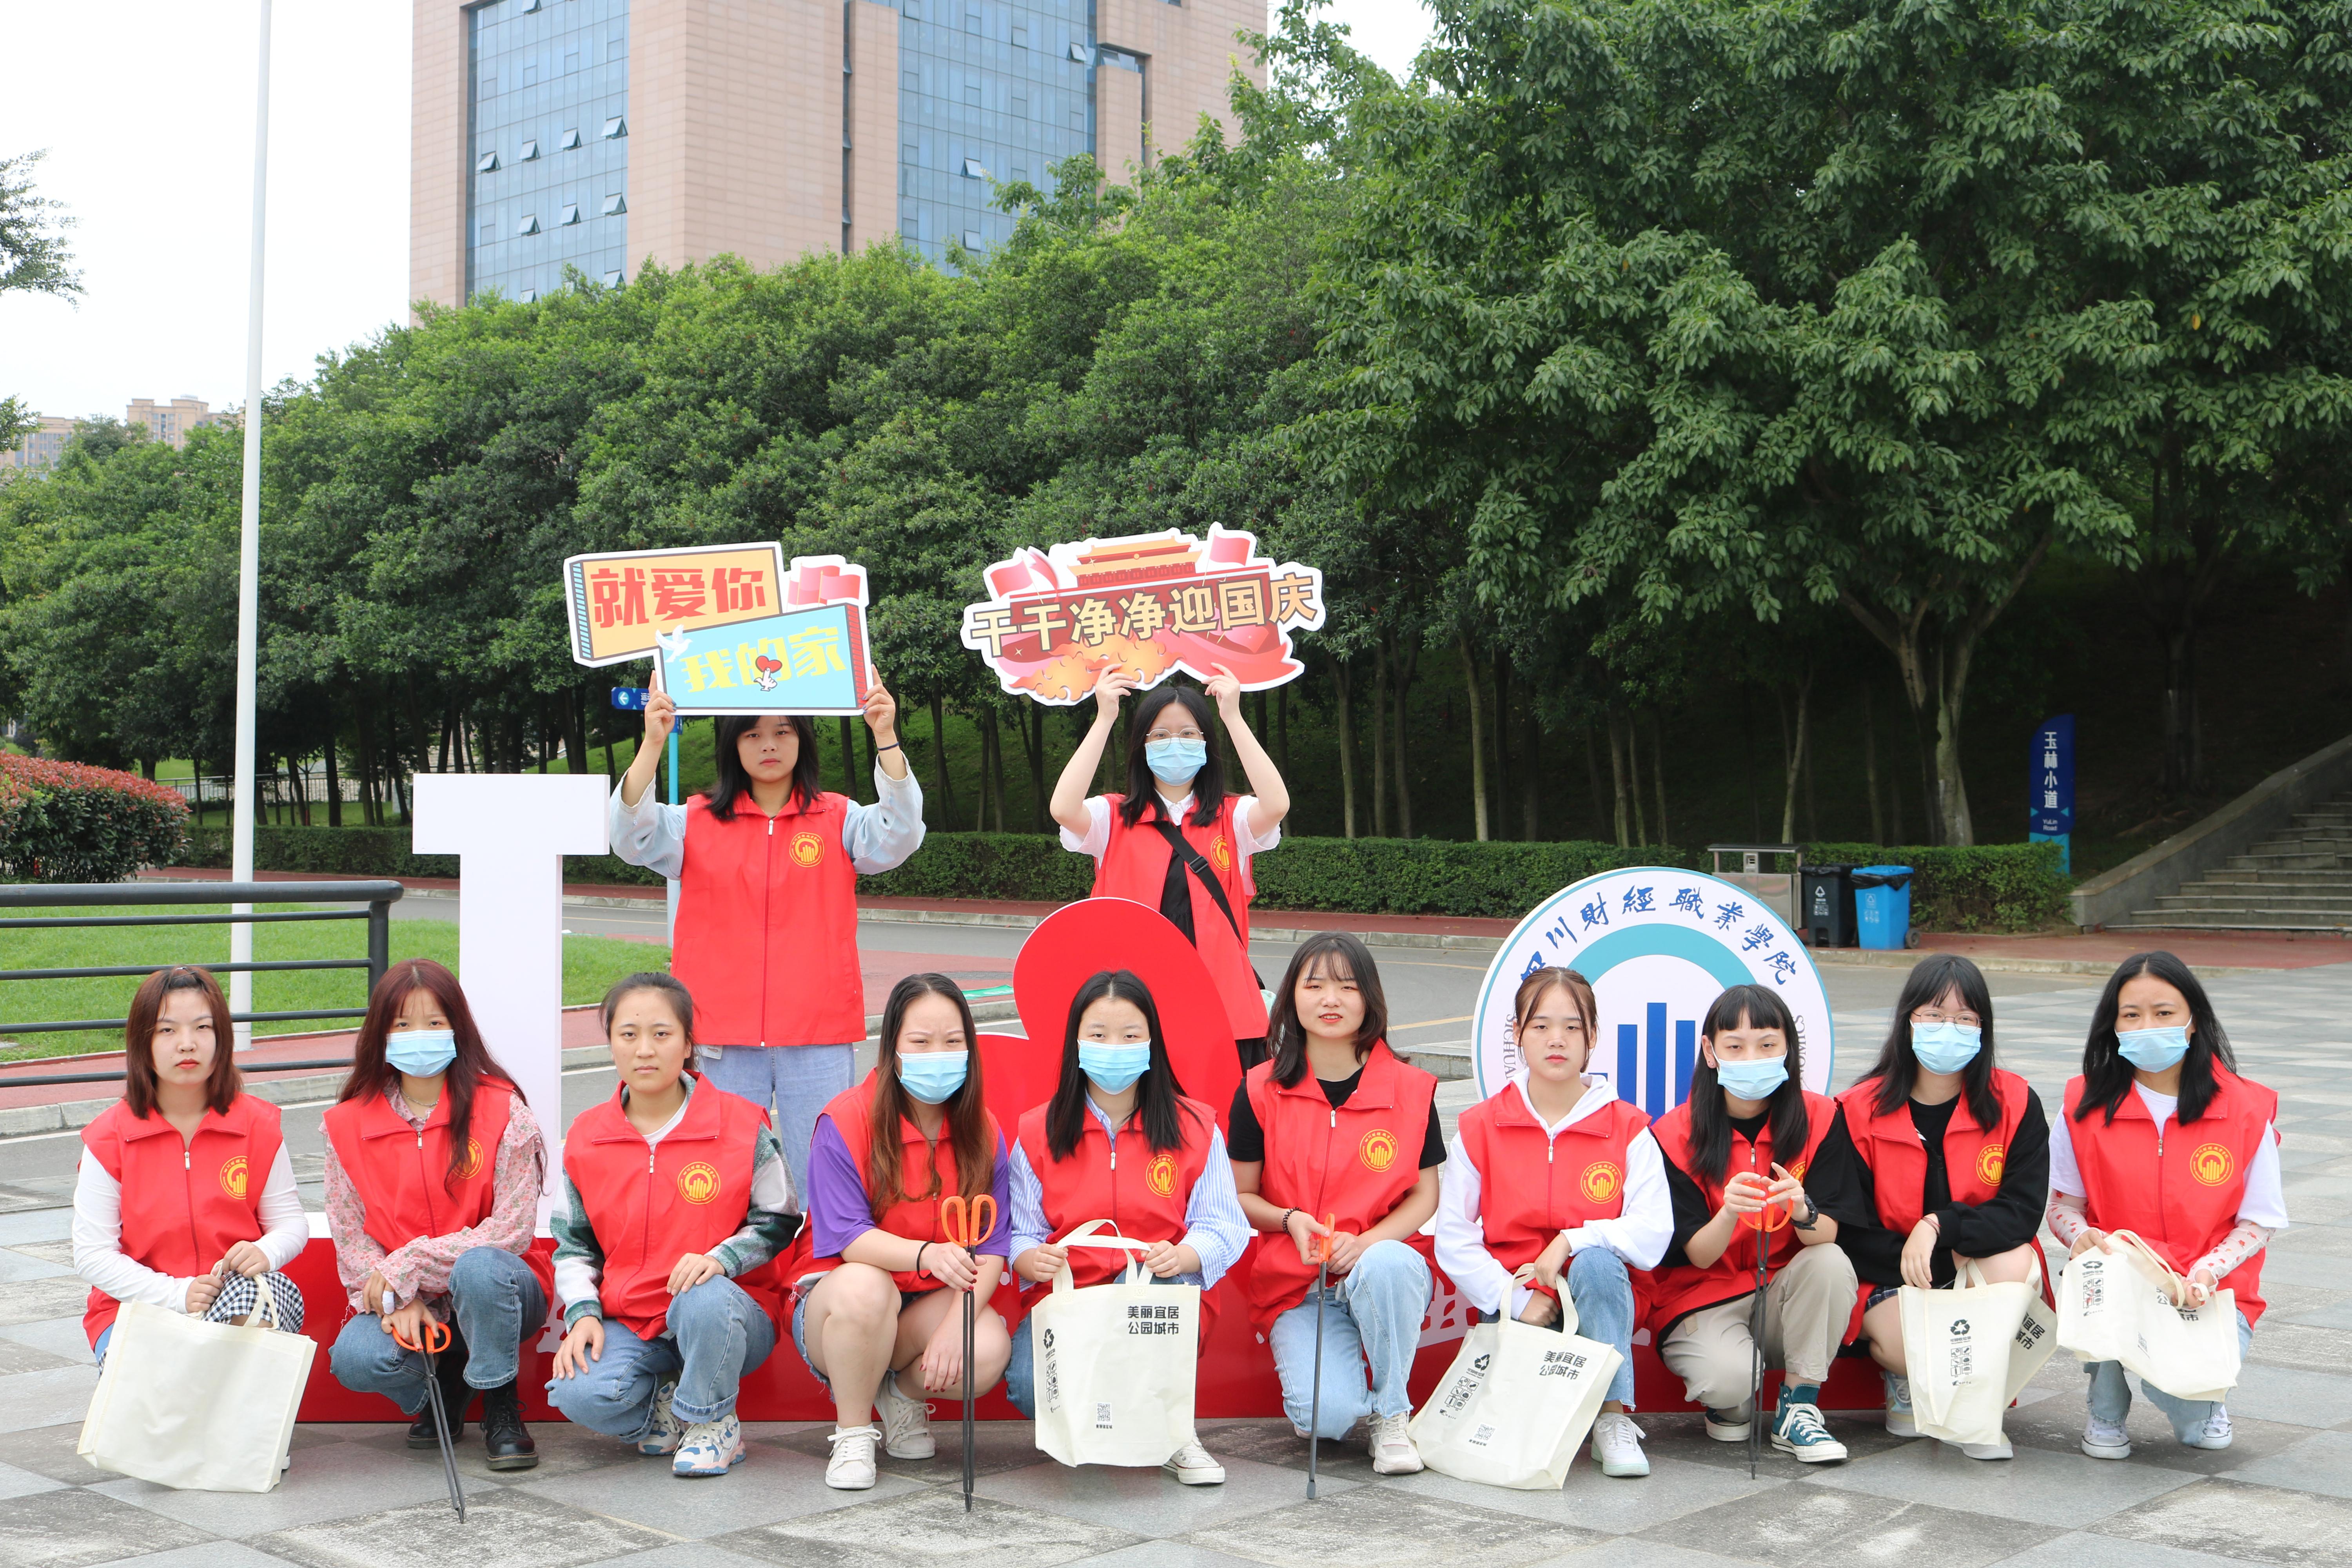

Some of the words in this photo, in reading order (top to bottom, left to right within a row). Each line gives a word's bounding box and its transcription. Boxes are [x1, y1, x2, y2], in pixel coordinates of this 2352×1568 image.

[590, 568, 766, 628] 就爱你
[971, 572, 1318, 657] 干干净净迎国庆
[679, 626, 848, 693] 我的家
[2044, 731, 2058, 808] 玉林小道
[1503, 1014, 1517, 1080] SICHUA
[1128, 1306, 1179, 1319] 美丽宜居
[1128, 1322, 1179, 1334] 公园城市
